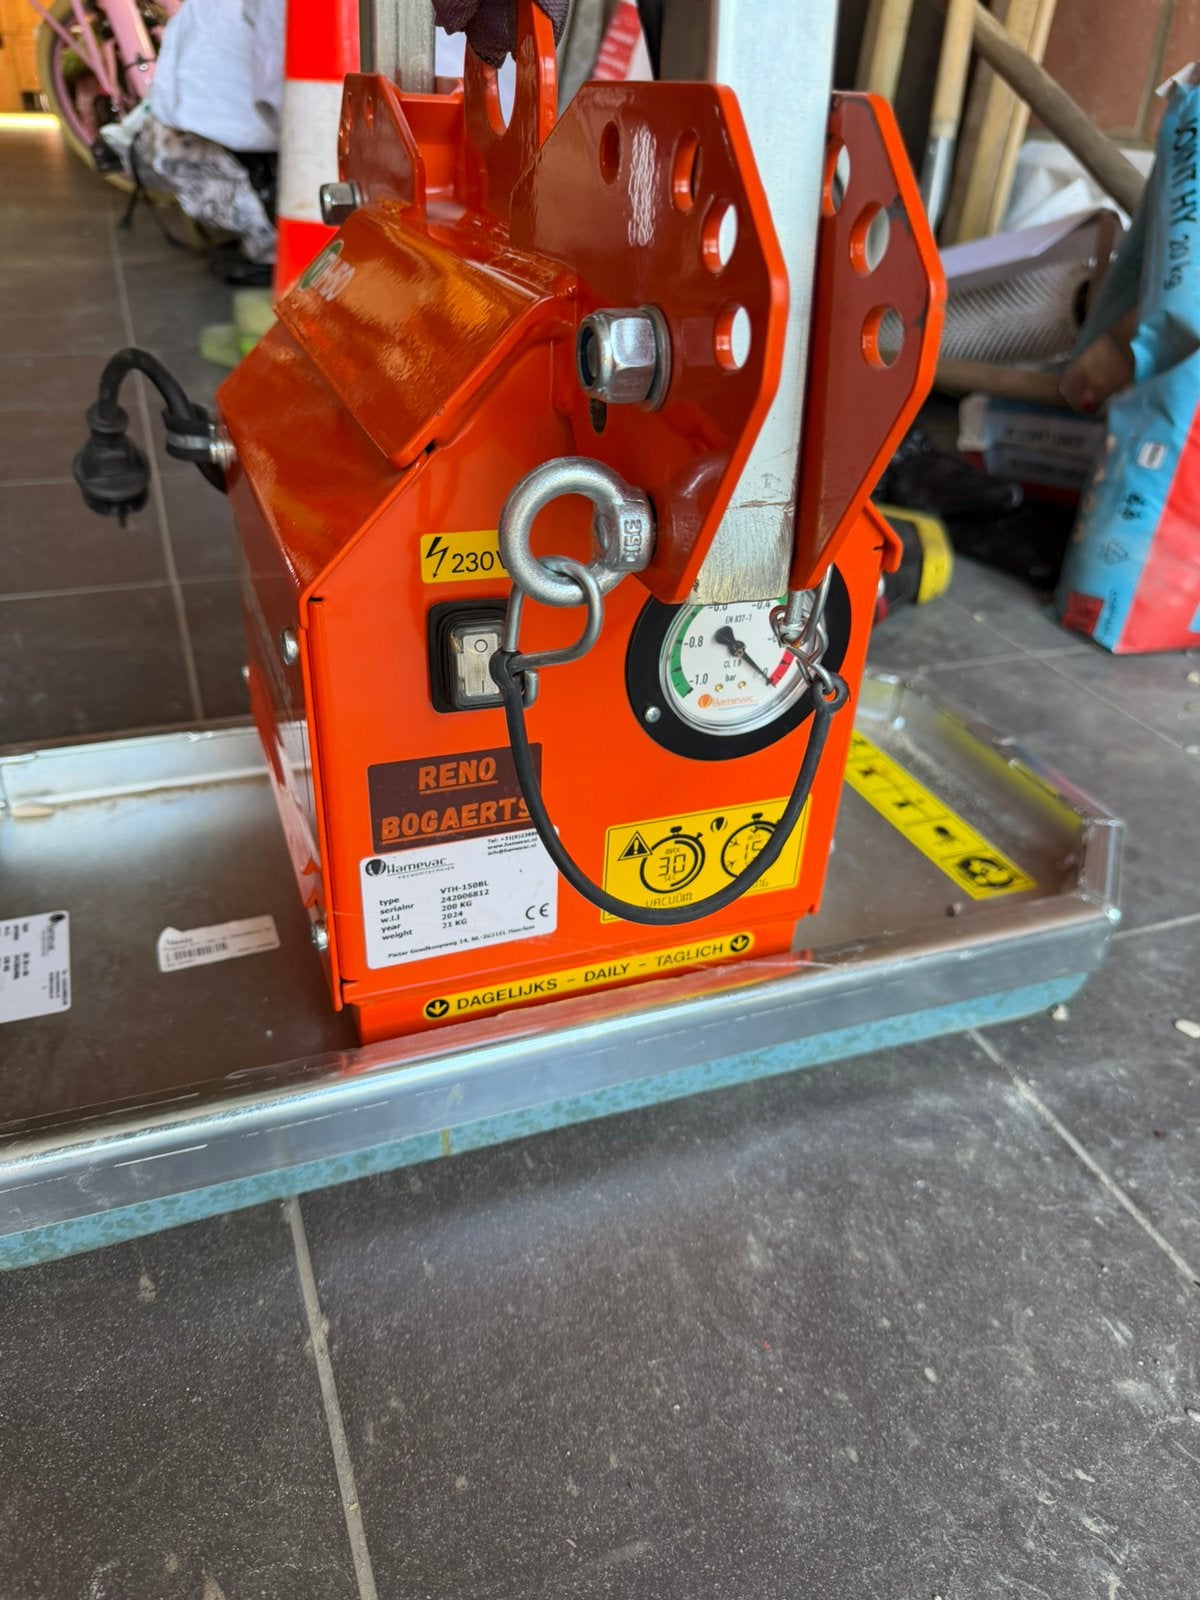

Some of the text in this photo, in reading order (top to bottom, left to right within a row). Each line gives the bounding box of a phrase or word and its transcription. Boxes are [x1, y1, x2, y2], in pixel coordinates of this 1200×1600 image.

[725, 615, 734, 624] EN
[684, 635, 704, 648] -0.8
[689, 673, 708, 685] -1.0
[725, 674, 737, 682] bar
[418, 757, 497, 791] RENO
[381, 797, 532, 840] BOGAERTS
[387, 857, 447, 874] Hamevac
[658, 853, 686, 877] 30
[380, 880, 490, 907] type VTH-150BL
[380, 888, 490, 915] serialnr 242006812
[441, 903, 457, 912] 200
[460, 900, 473, 909] KG
[381, 911, 463, 934] year 2024
[382, 917, 467, 941] weight 21 KG
[456, 978, 557, 1010] DAGELIJKS
[584, 962, 629, 984] DAILY
